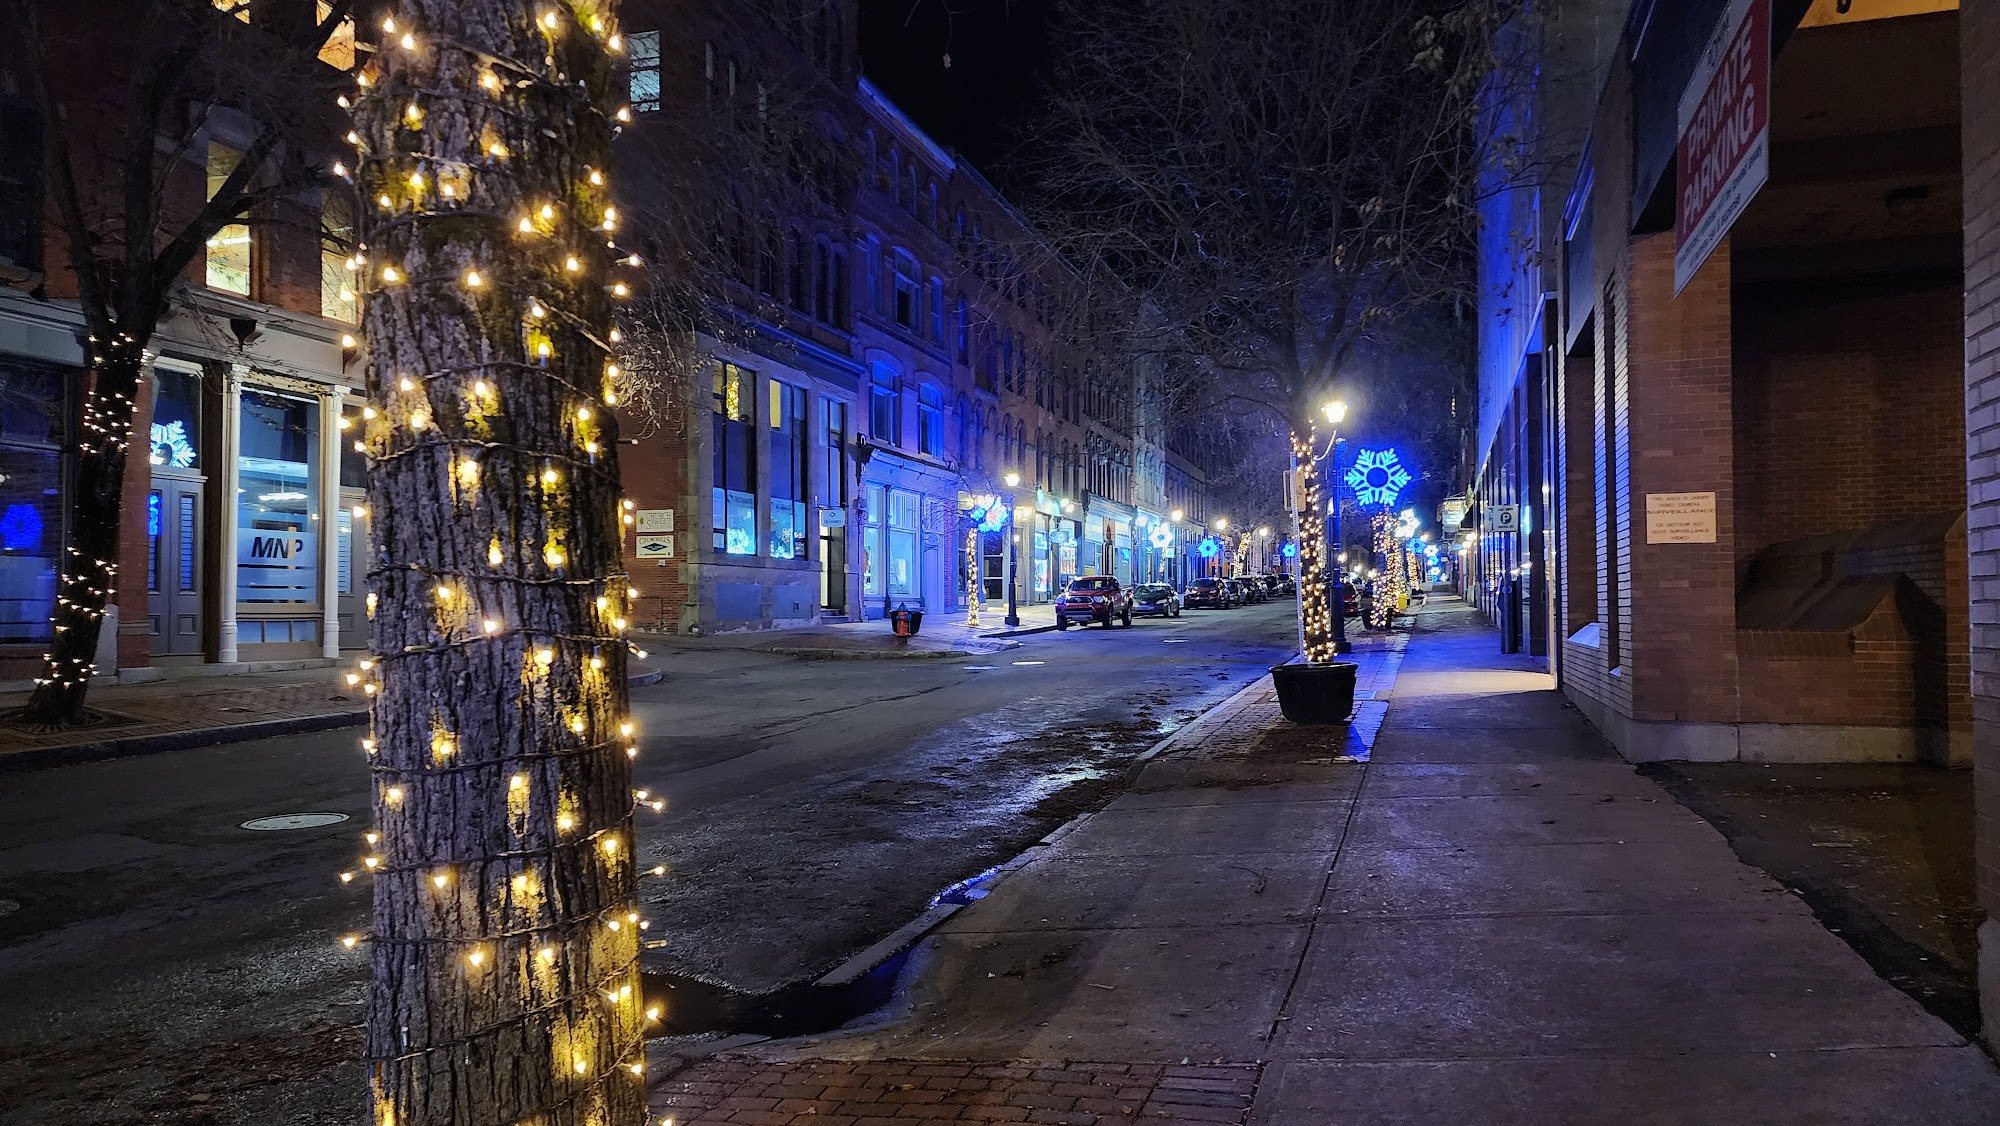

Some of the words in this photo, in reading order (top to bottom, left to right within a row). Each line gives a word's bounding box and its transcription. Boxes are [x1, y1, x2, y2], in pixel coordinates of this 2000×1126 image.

[1683, 83, 1754, 234] PARKING
[1688, 16, 1752, 175] PRIVATE
[251, 536, 304, 559] MNP
